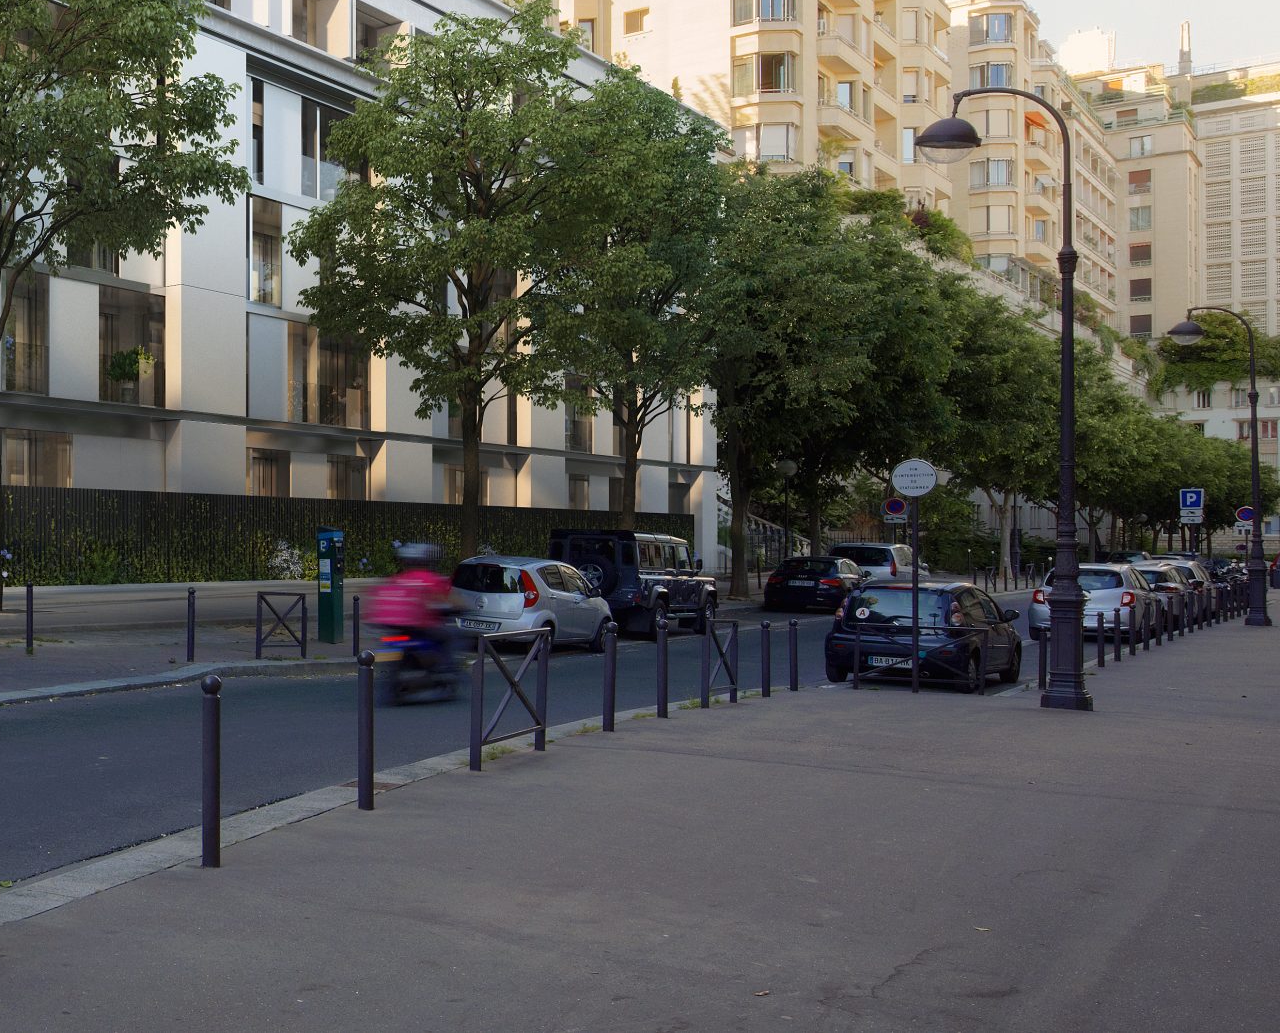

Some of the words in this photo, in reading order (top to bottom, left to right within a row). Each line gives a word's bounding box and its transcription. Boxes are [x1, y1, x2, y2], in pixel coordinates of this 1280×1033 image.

[1186, 492, 1197, 506] P
[320, 540, 327, 551] P
[859, 609, 866, 617] A
